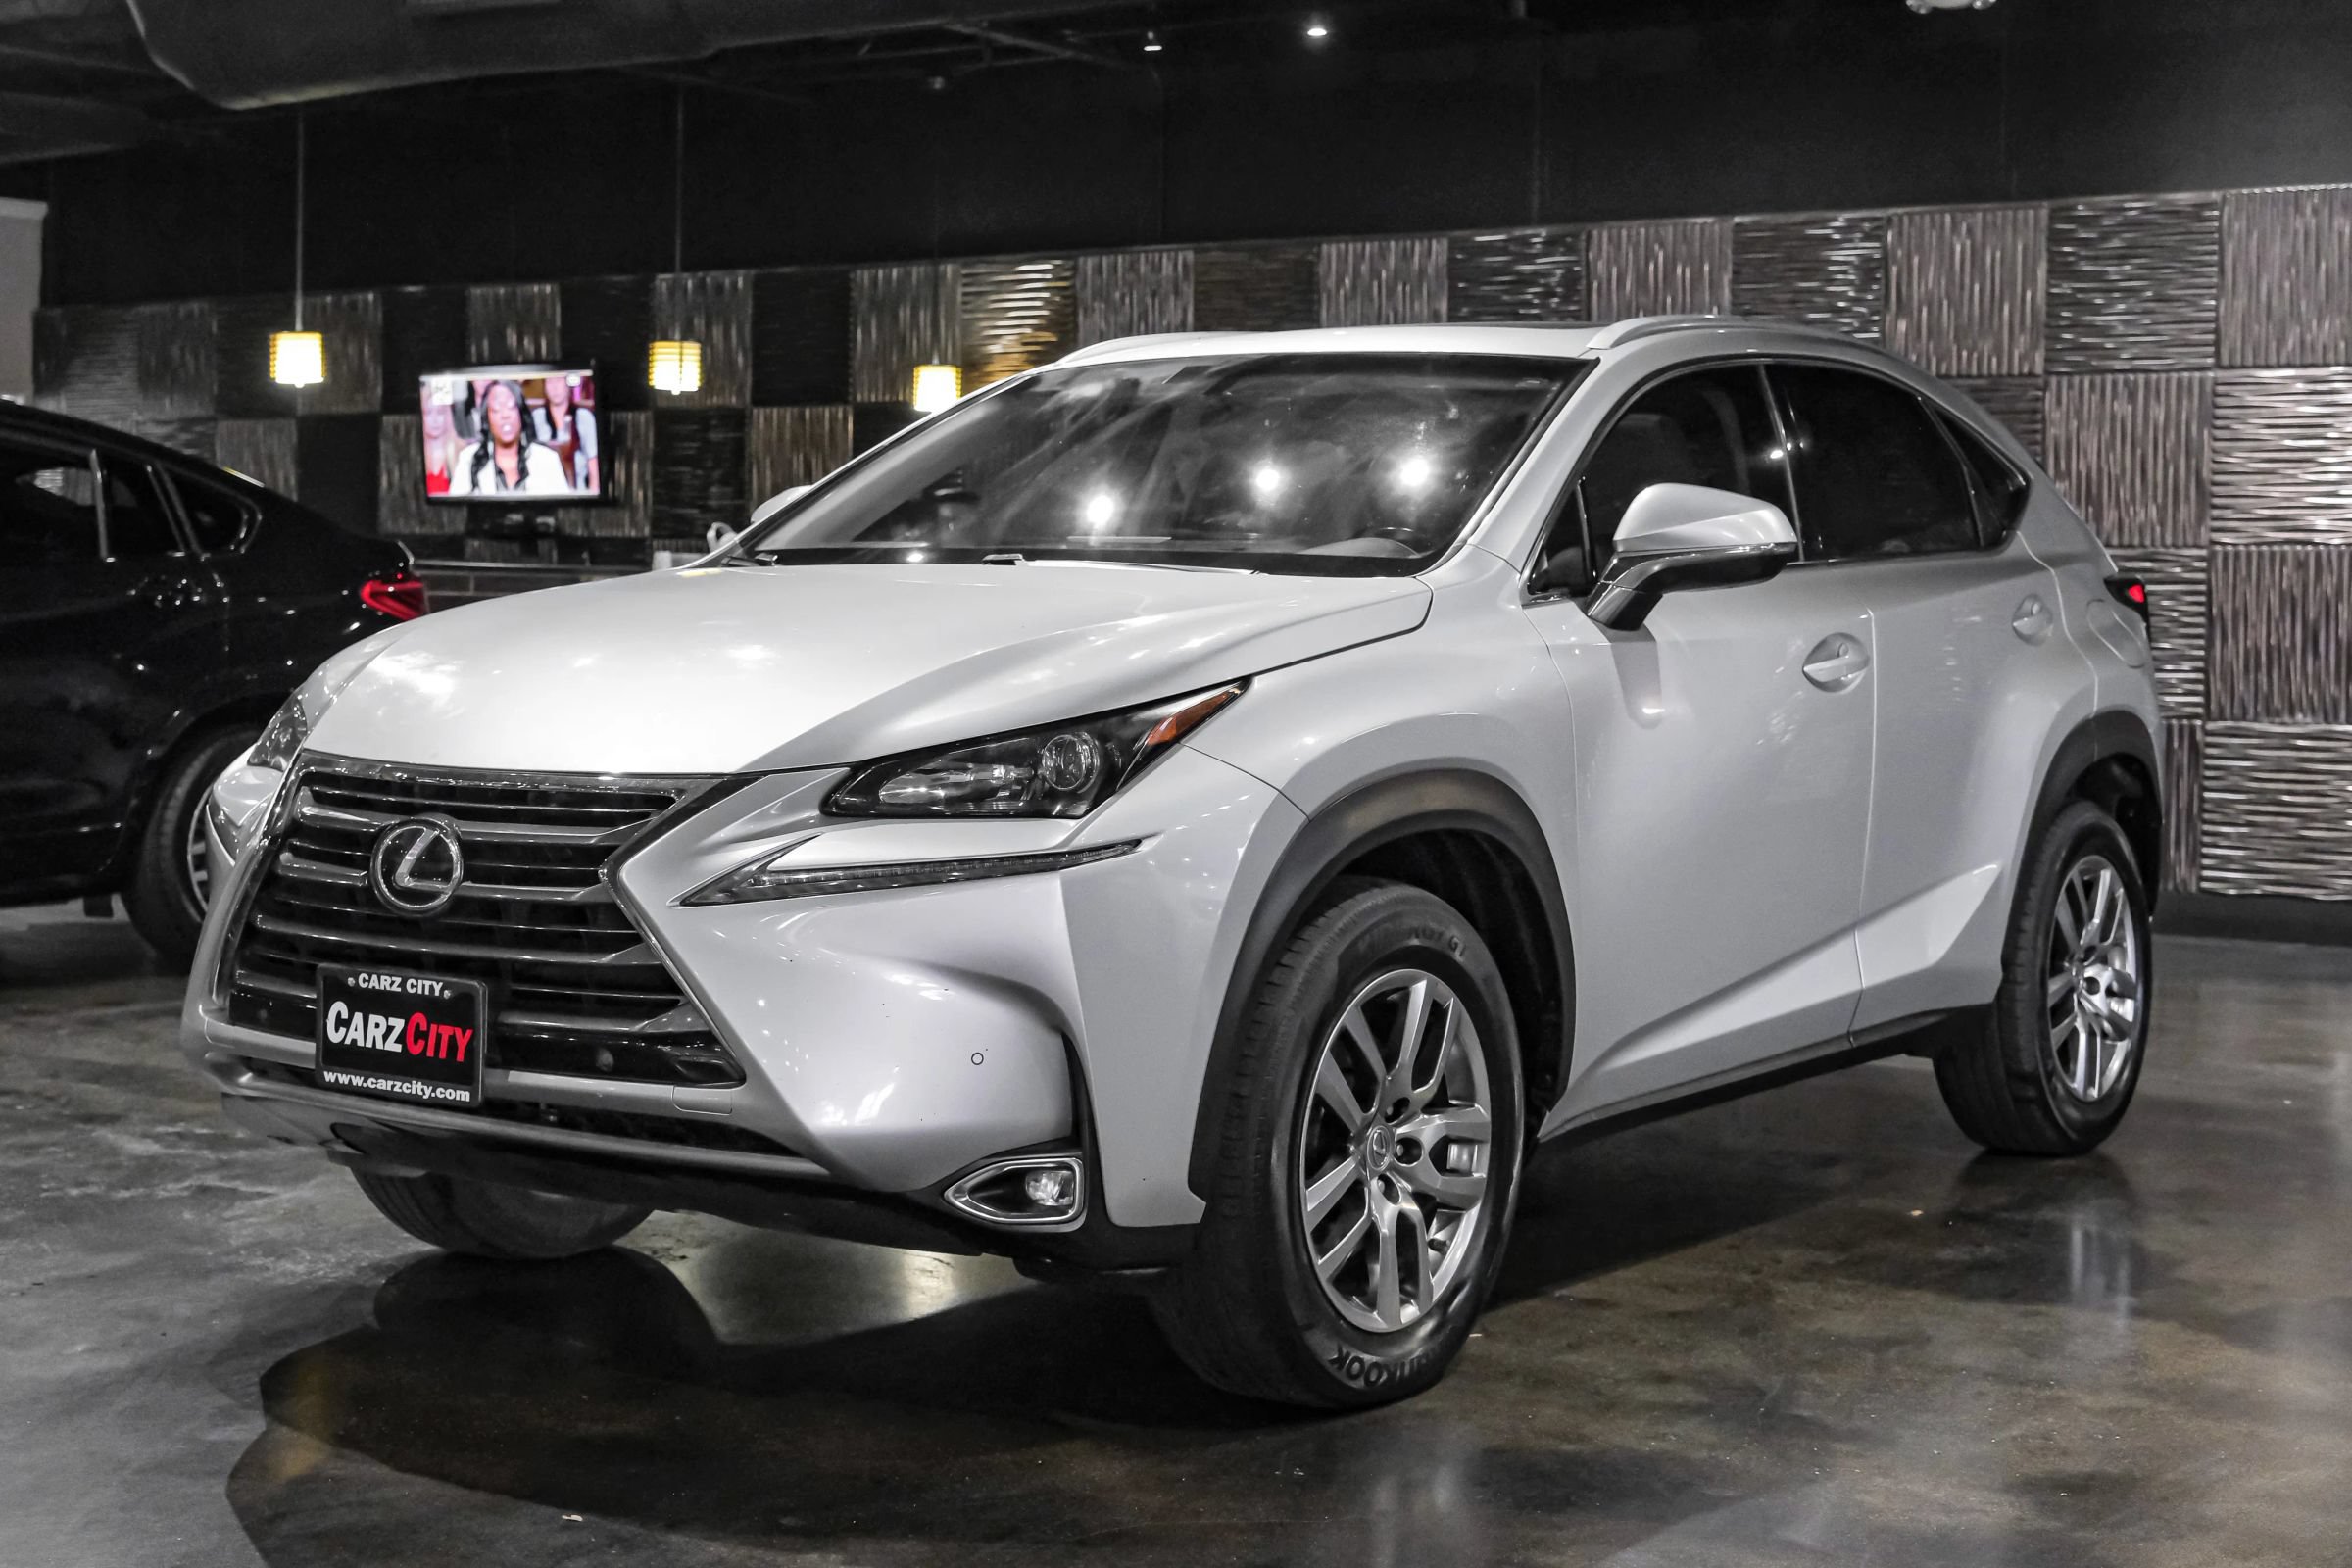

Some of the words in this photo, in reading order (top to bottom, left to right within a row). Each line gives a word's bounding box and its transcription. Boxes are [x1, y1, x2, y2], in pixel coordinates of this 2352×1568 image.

[358, 973, 402, 992] CARZ
[406, 978, 443, 996] CITY
[323, 1071, 470, 1102] www.carzcity.com
